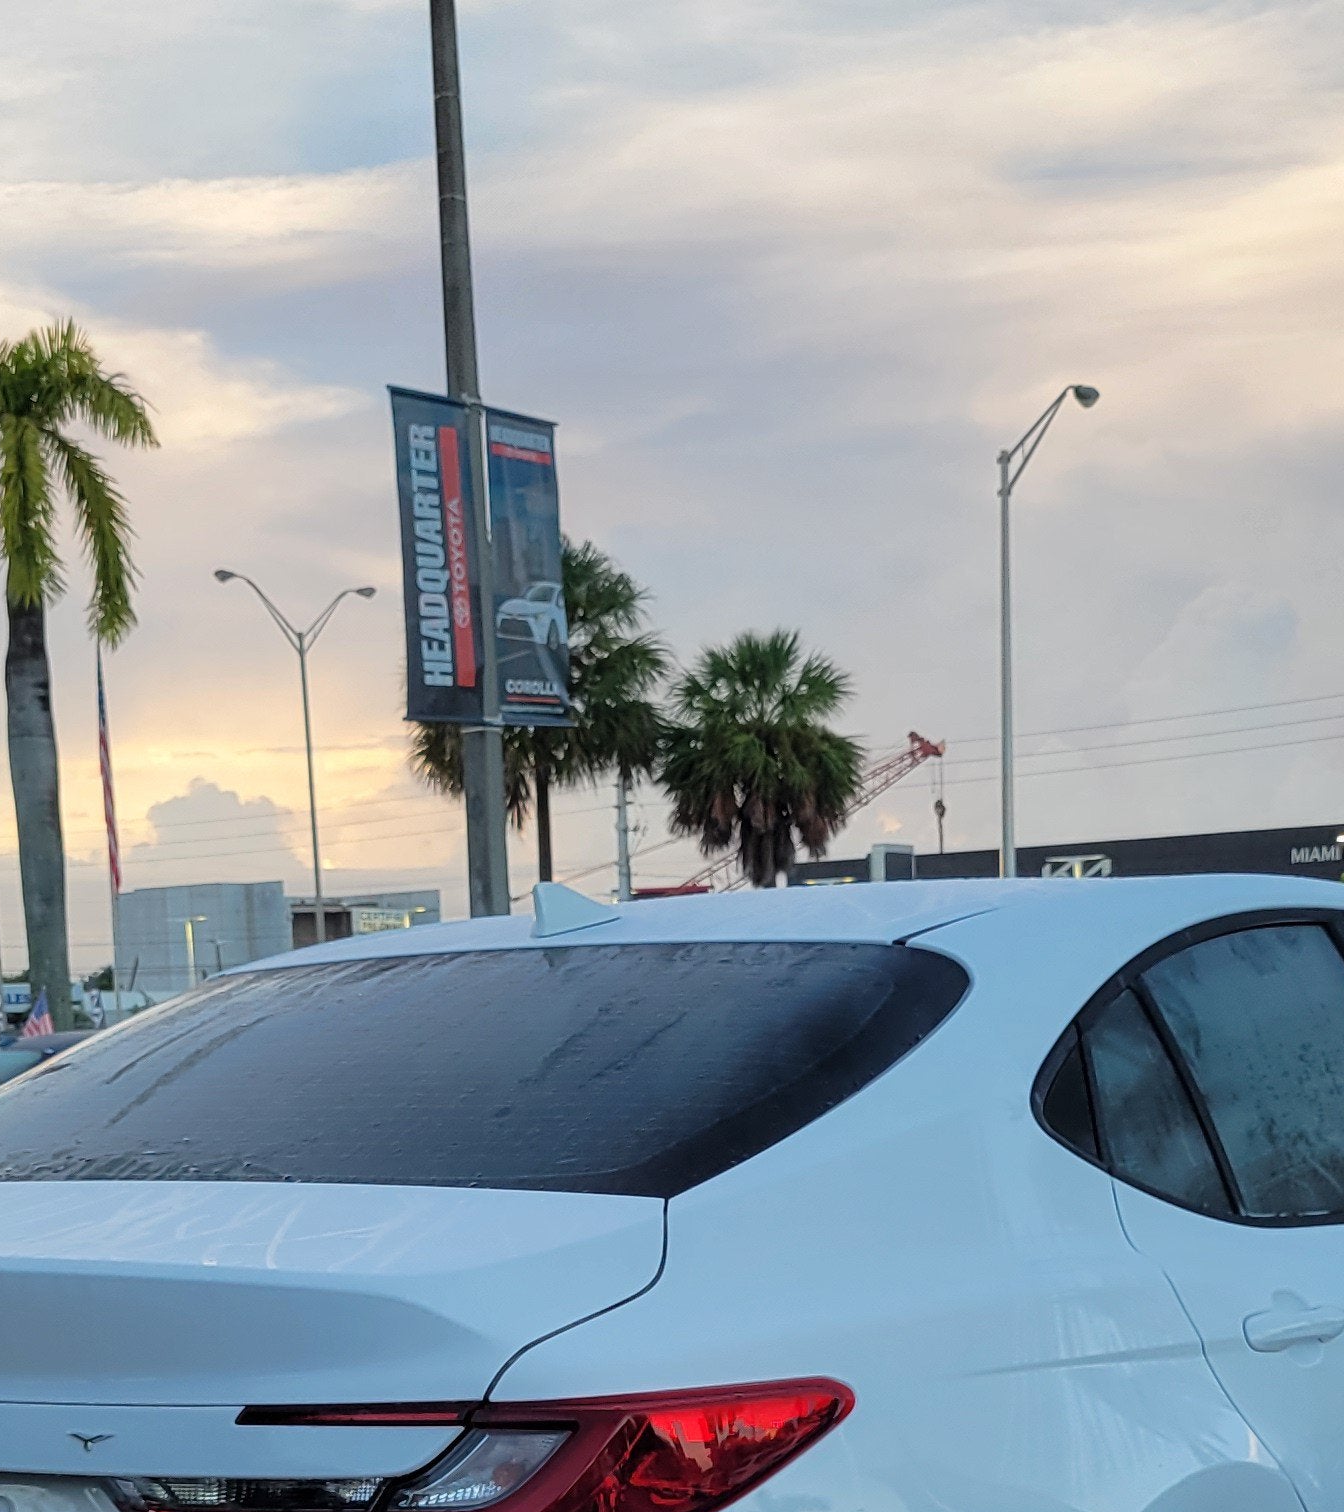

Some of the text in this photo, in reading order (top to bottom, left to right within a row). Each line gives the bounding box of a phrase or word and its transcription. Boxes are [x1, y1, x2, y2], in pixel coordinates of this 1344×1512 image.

[409, 423, 454, 688] HEADQUARTER
[447, 498, 468, 593] TOYOTA
[1290, 843, 1340, 865] MIAMI
